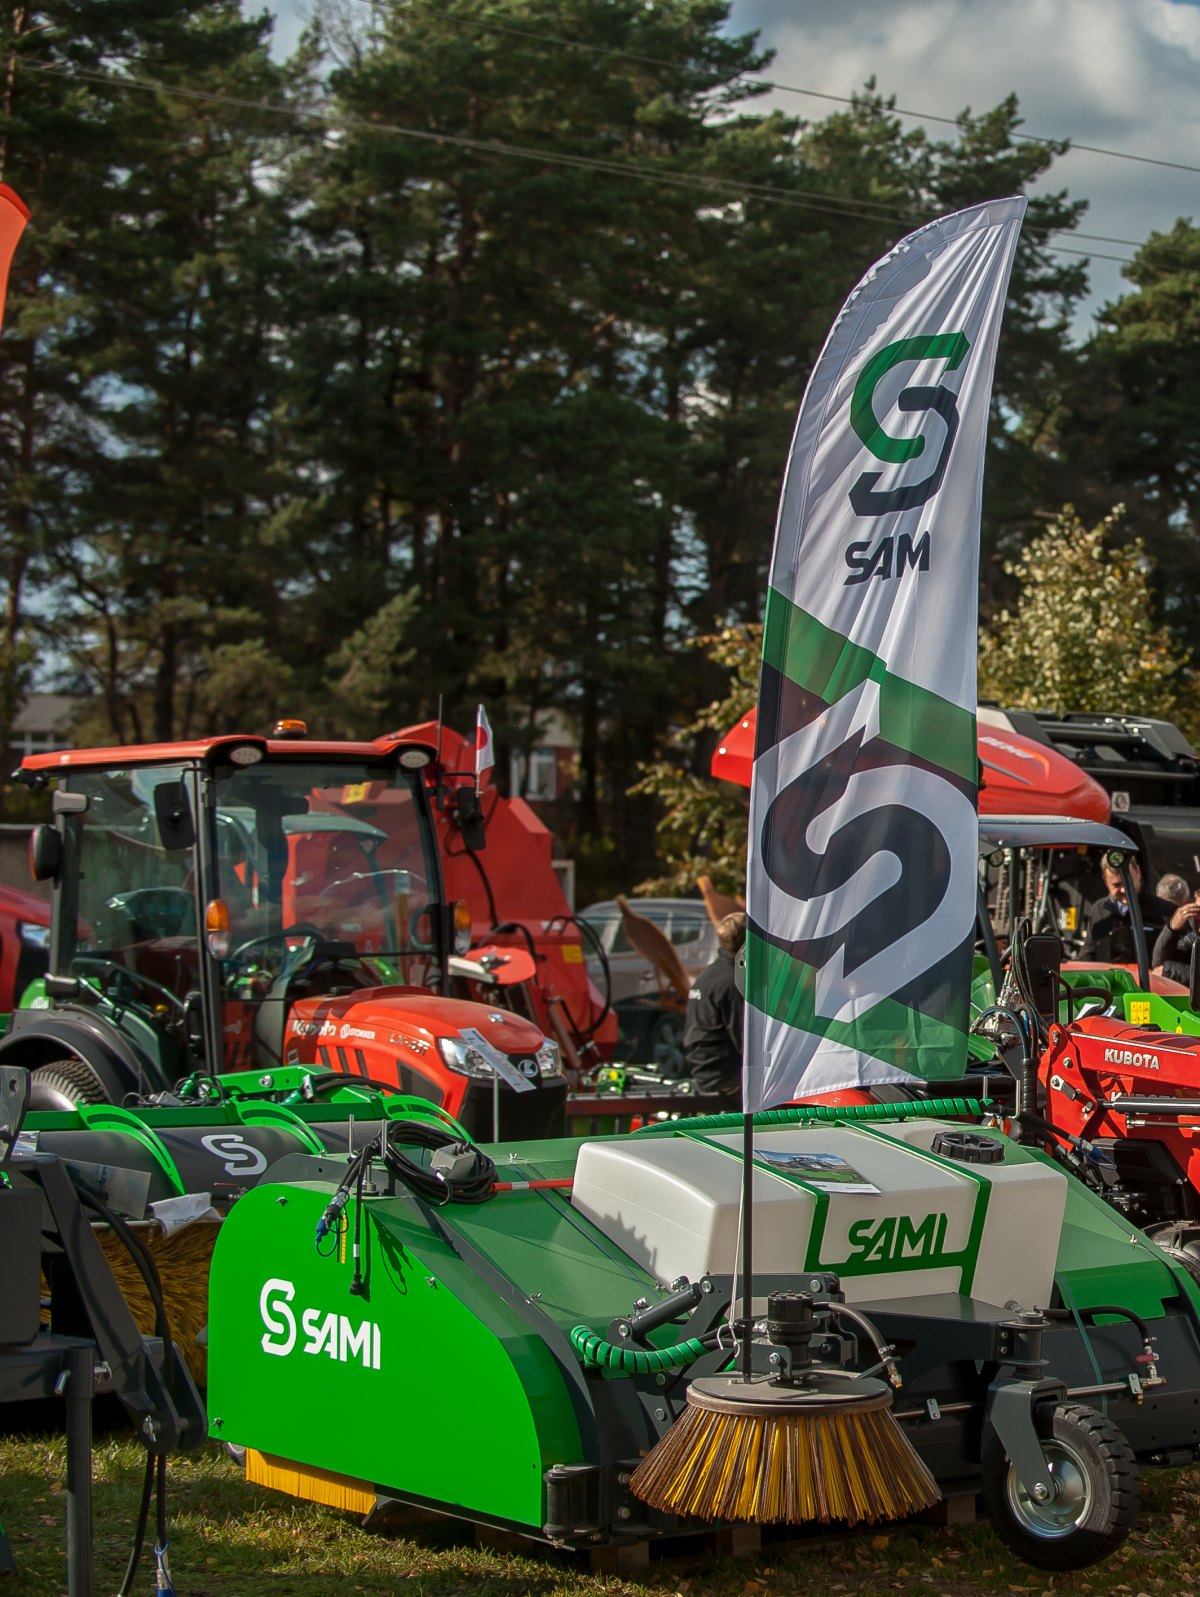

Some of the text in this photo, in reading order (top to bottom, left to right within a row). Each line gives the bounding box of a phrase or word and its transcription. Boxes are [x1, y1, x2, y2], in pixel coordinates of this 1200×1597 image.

[1104, 1047, 1161, 1071] KUBOTA
[845, 1212, 949, 1263] SAMI
[301, 1307, 382, 1371] SAMI
